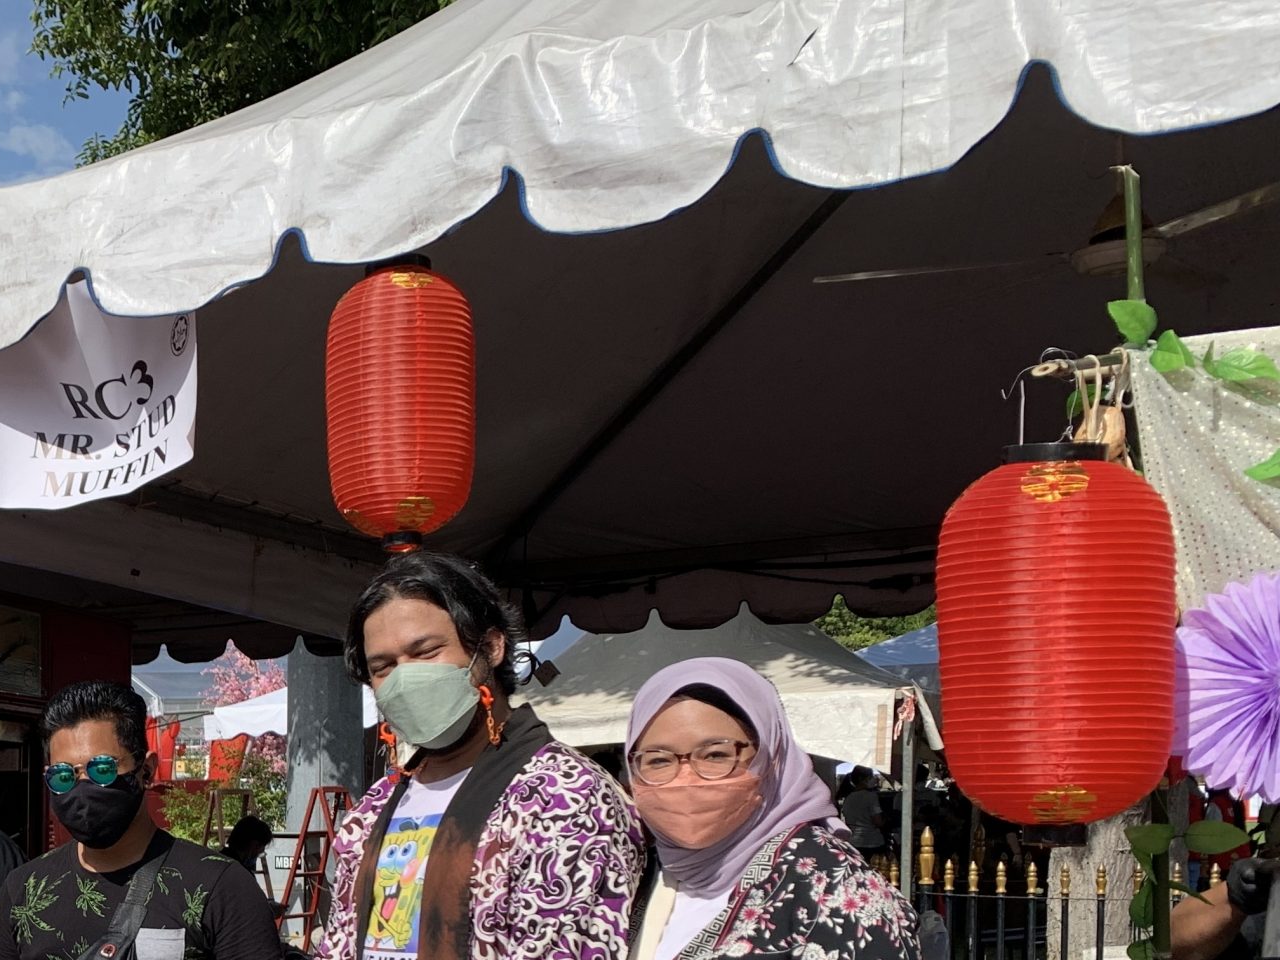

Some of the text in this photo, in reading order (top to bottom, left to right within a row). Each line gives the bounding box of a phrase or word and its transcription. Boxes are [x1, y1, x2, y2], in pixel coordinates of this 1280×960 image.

[60, 359, 154, 421] RC3
[31, 394, 177, 461] MR. STUD
[42, 439, 170, 498] MUFFIN
